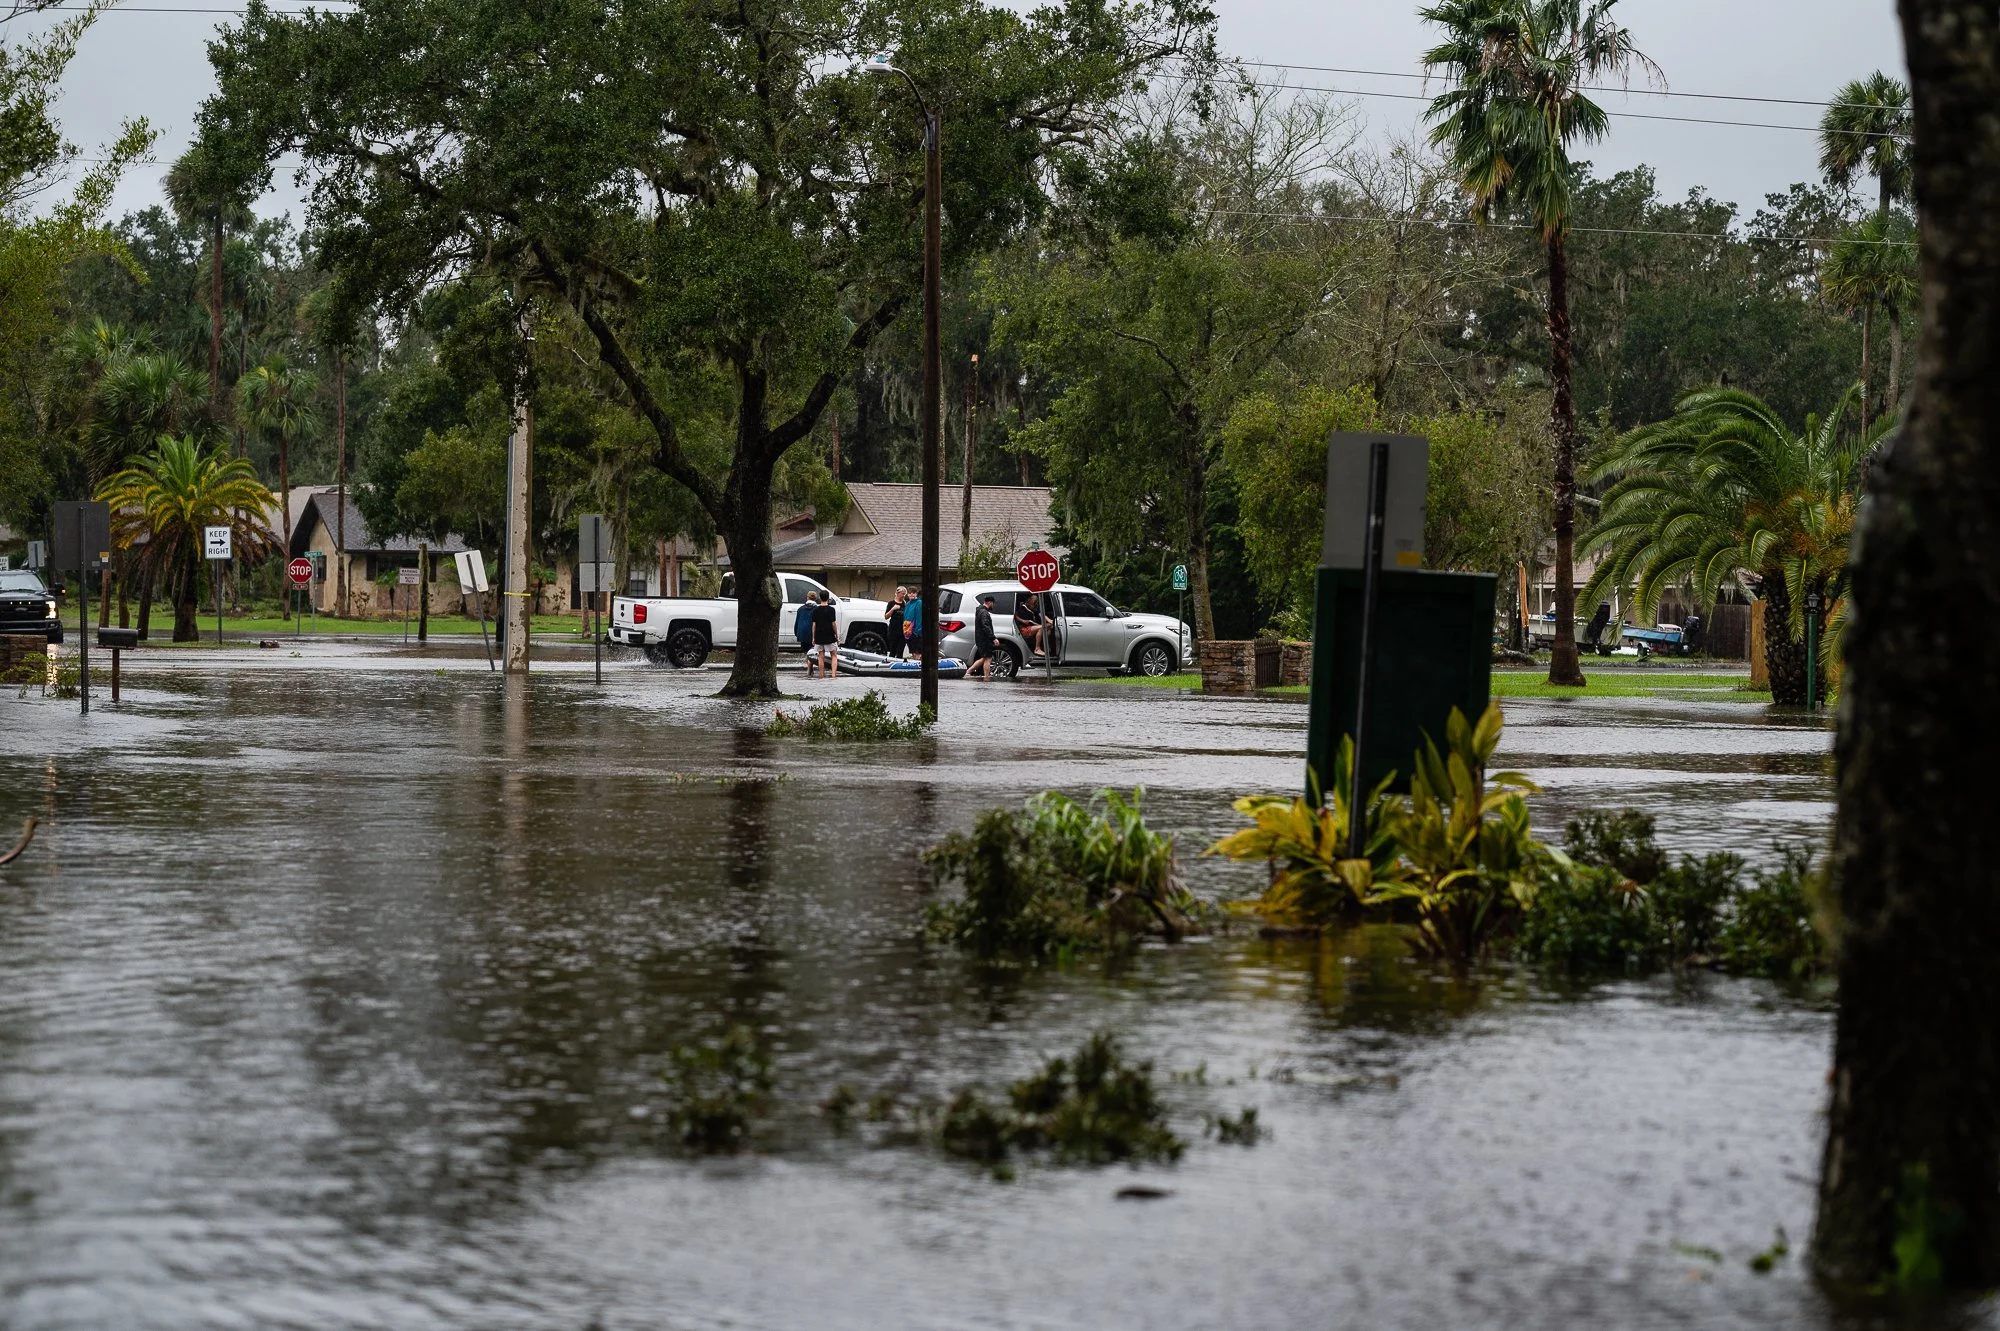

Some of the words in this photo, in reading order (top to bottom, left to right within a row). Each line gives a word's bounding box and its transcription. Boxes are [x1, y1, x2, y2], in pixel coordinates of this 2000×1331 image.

[209, 530, 228, 538] KEEP
[208, 547, 229, 555] RIGHT
[290, 565, 312, 576] STOP
[1020, 562, 1056, 581] STOP
